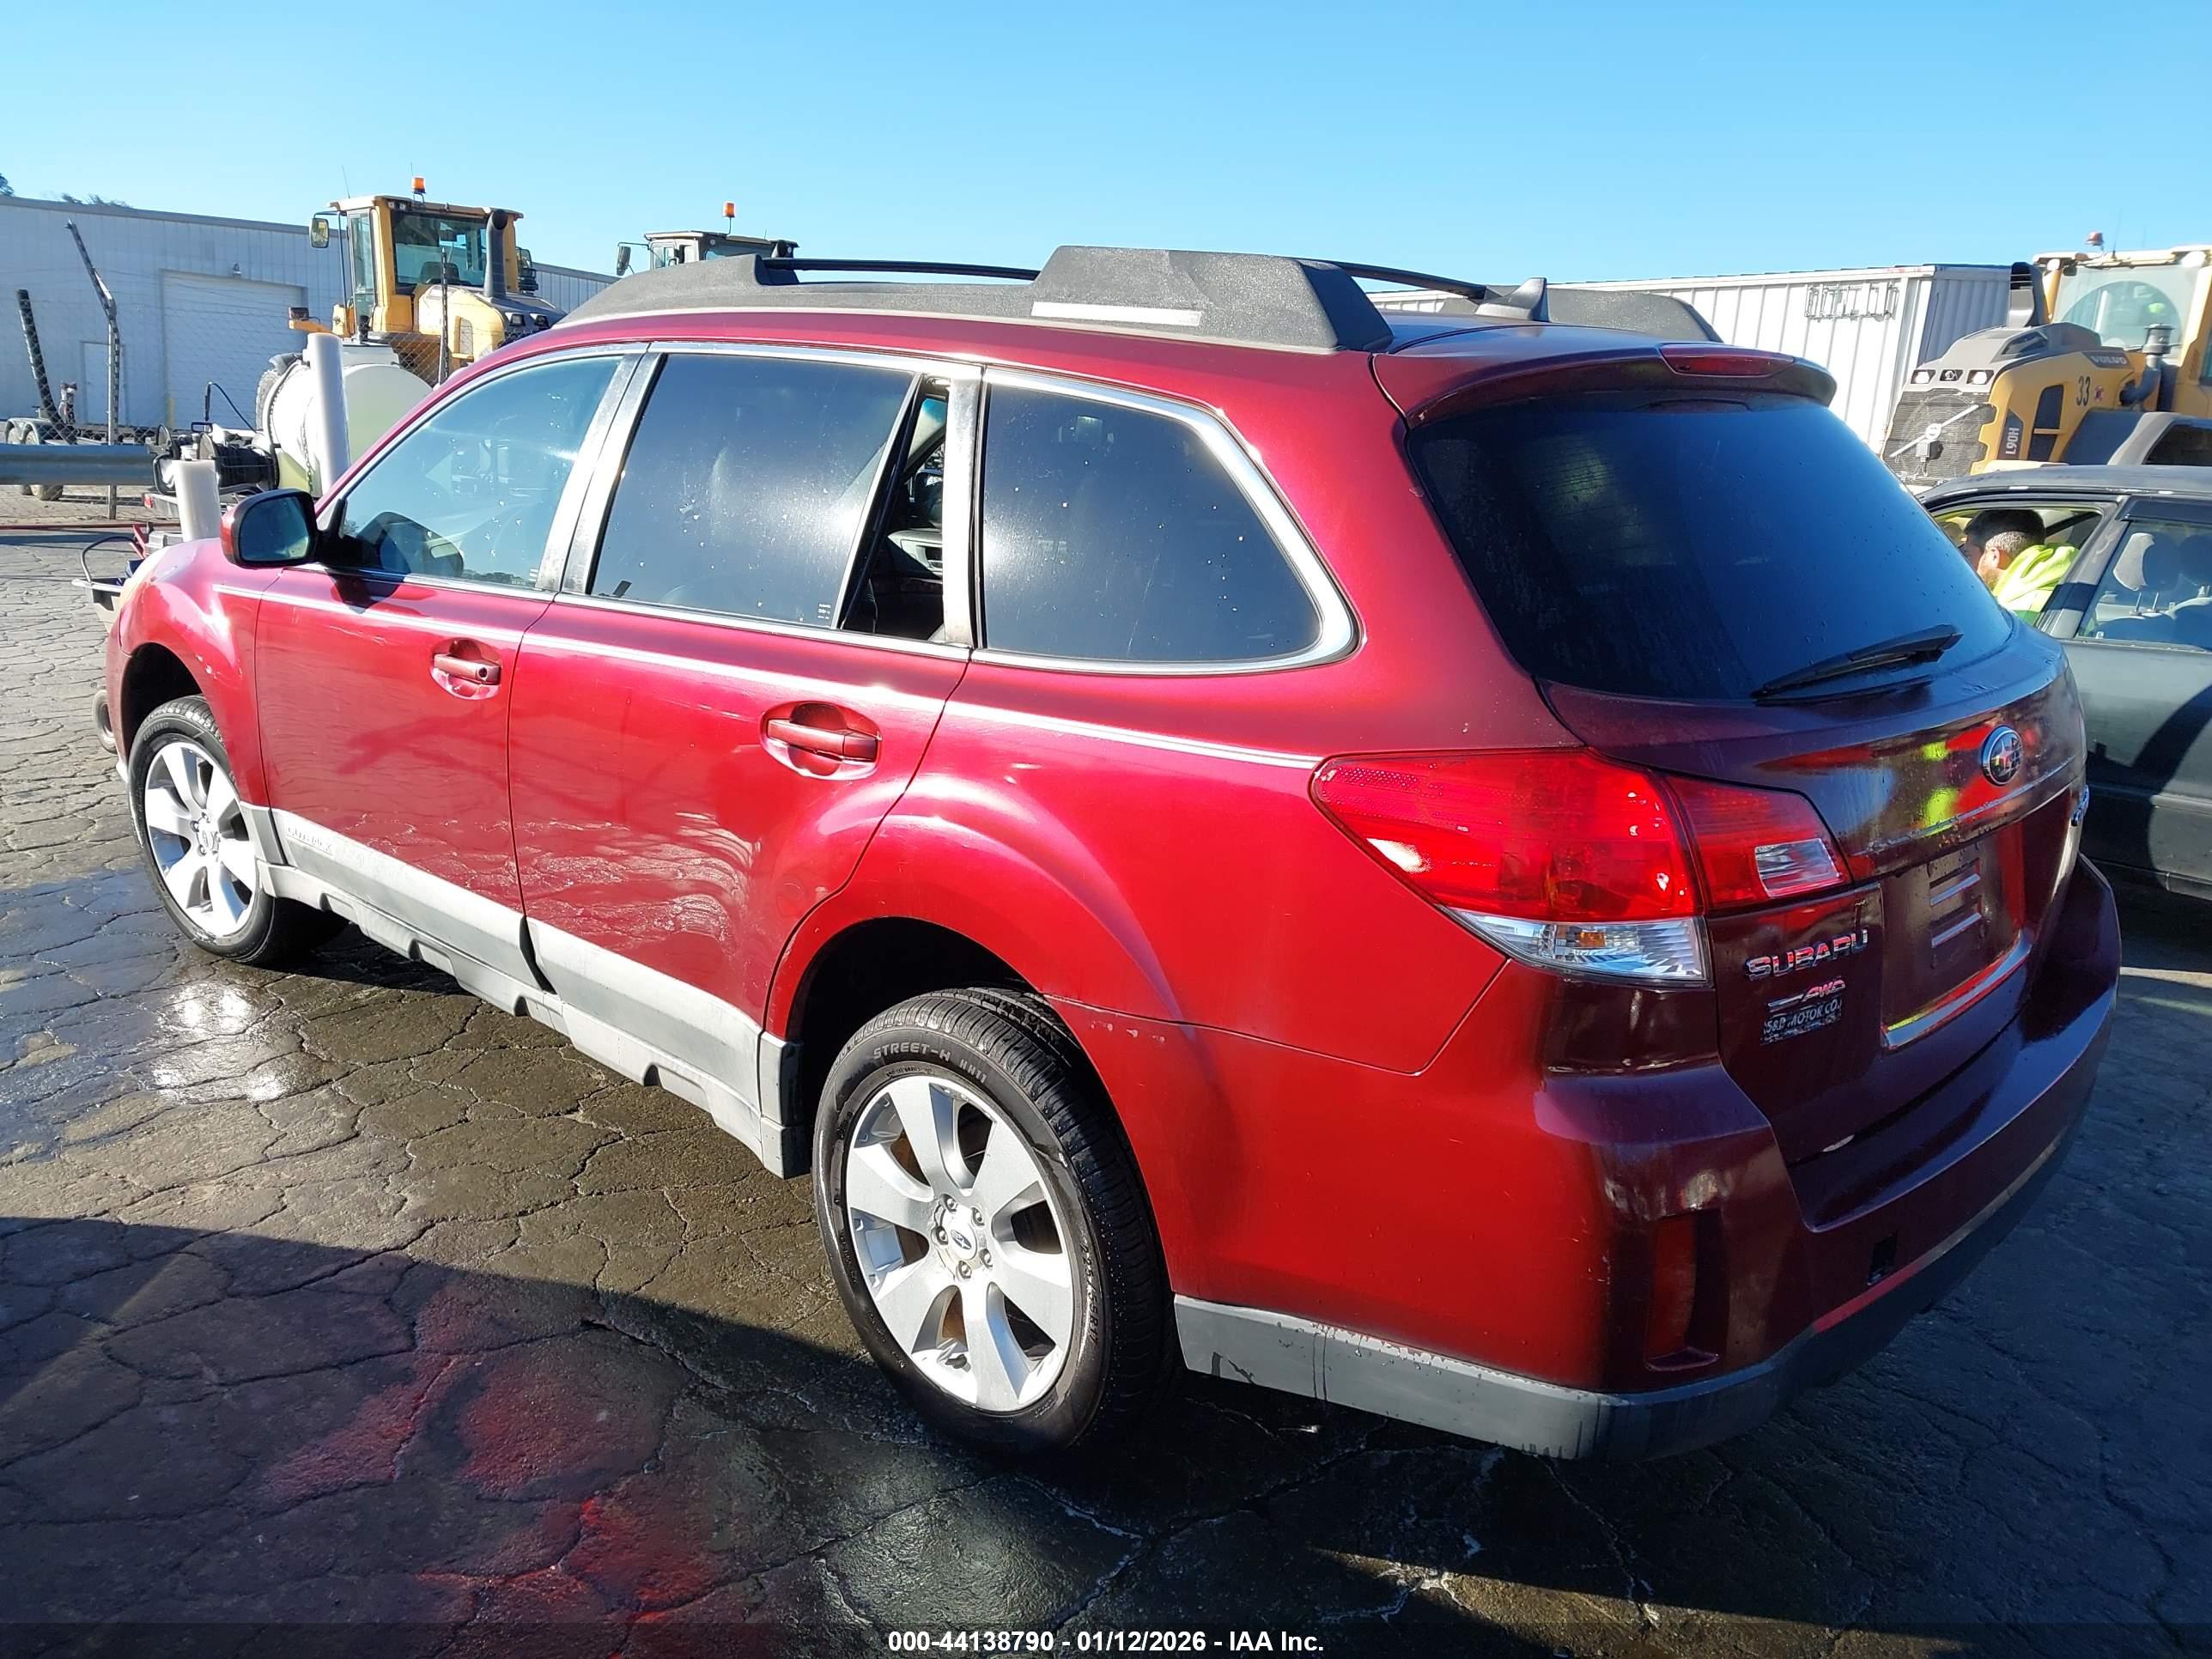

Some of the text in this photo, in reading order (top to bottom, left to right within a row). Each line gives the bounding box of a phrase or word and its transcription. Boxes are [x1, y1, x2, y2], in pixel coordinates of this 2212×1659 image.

[2090, 355, 2129, 365] VOLVO
[2075, 375, 2091, 406] 33
[2005, 427, 2021, 455] L90H
[1744, 928, 1869, 981] SUBARU
[1802, 978, 1846, 1003] AWD
[1787, 1006, 1824, 1028] MOTOR
[872, 1042, 951, 1062] STREET-H
